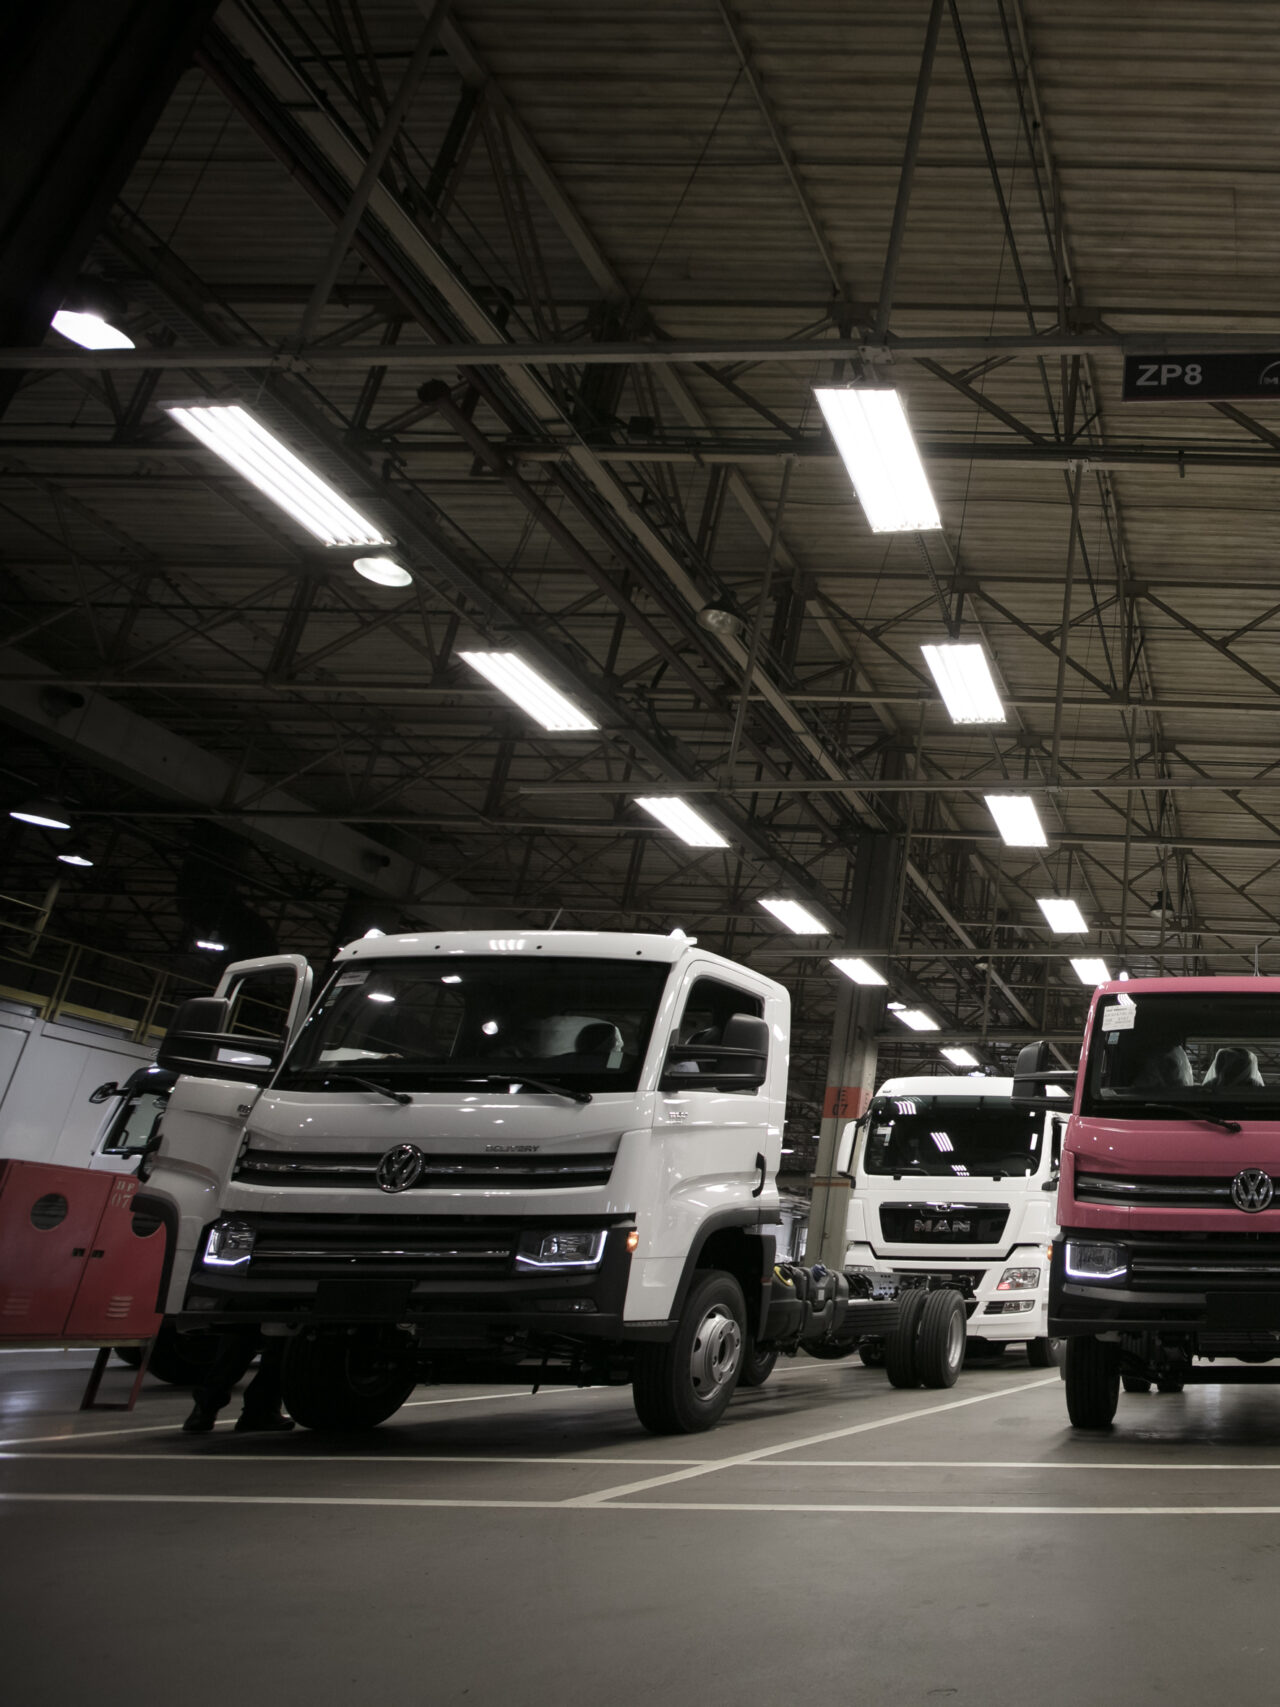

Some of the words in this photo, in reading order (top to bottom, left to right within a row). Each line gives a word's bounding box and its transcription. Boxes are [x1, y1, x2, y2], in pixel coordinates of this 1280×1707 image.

[1135, 364, 1203, 386] ZP8
[485, 1144, 540, 1153] DELIVERY
[914, 1219, 971, 1233] MAN
